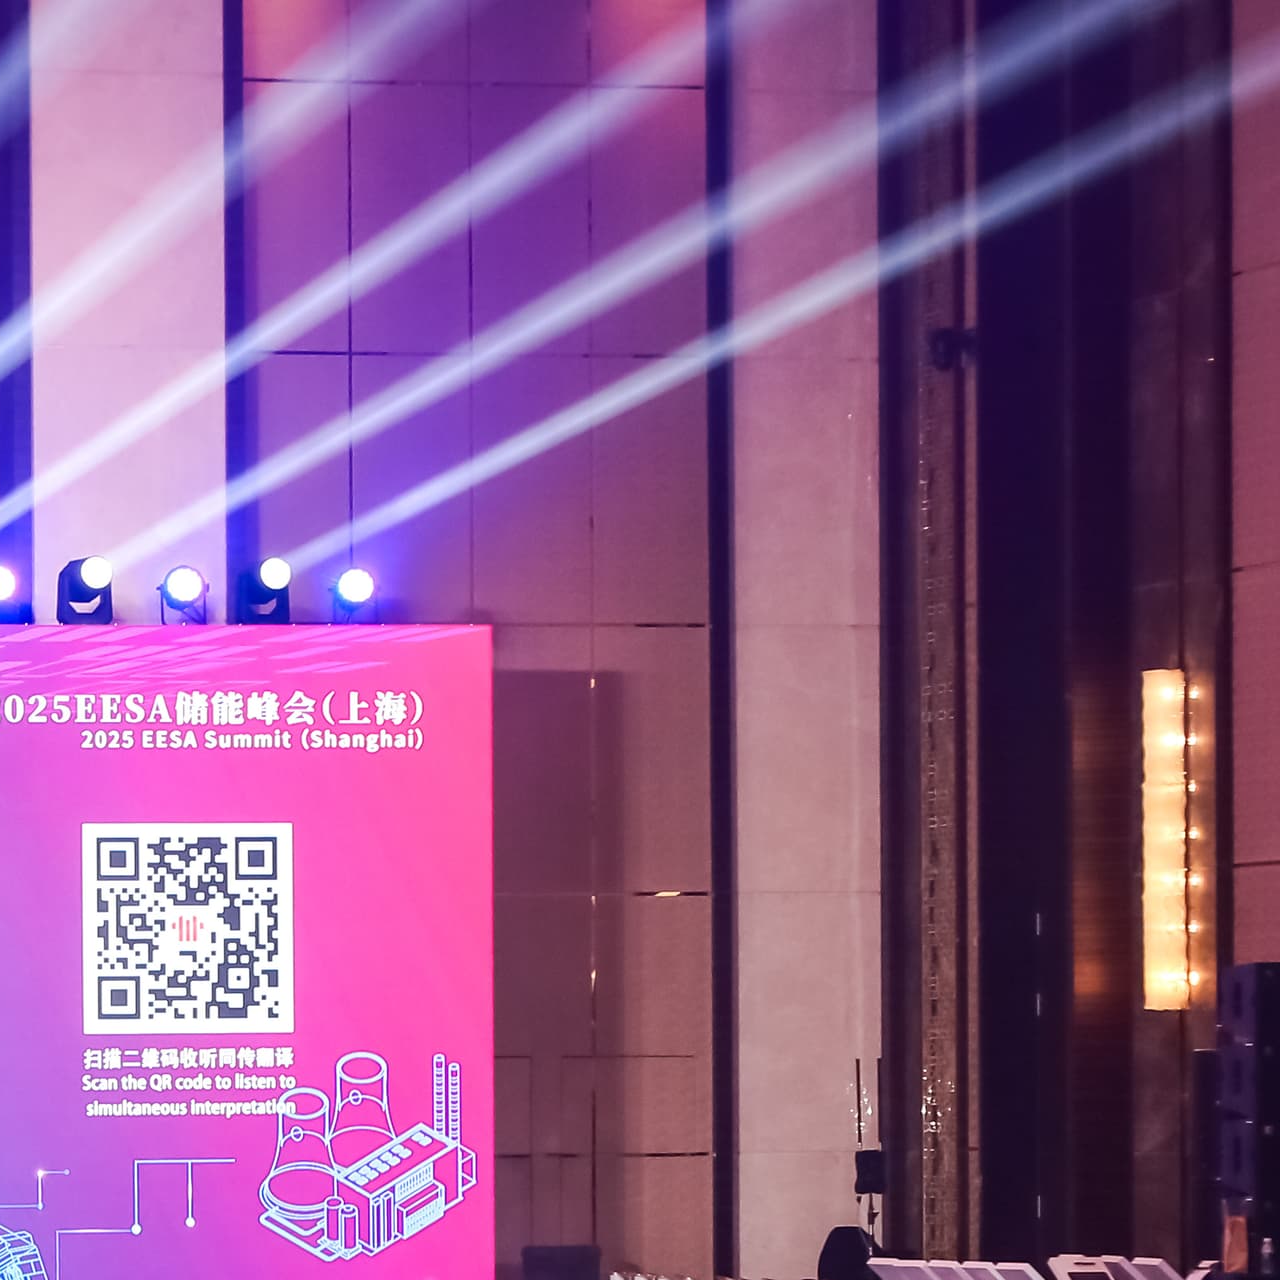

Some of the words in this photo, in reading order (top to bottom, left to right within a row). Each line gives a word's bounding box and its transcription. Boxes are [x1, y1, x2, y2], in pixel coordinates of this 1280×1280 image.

[81, 730, 134, 749] 2025
[142, 730, 198, 749] EESA
[204, 730, 292, 749] Summit
[301, 728, 423, 753] (Shanghai)
[83, 1047, 294, 1070] 扫描二维码收听同传翻译
[81, 1073, 118, 1091] Scan
[121, 1073, 147, 1090] the
[149, 1073, 173, 1092] QR
[174, 1073, 212, 1090] code
[215, 1075, 232, 1090] to
[234, 1073, 276, 1090] listen
[279, 1075, 297, 1089] to
[86, 1099, 188, 1117] simultaneous
[190, 1098, 297, 1119] interpretation
